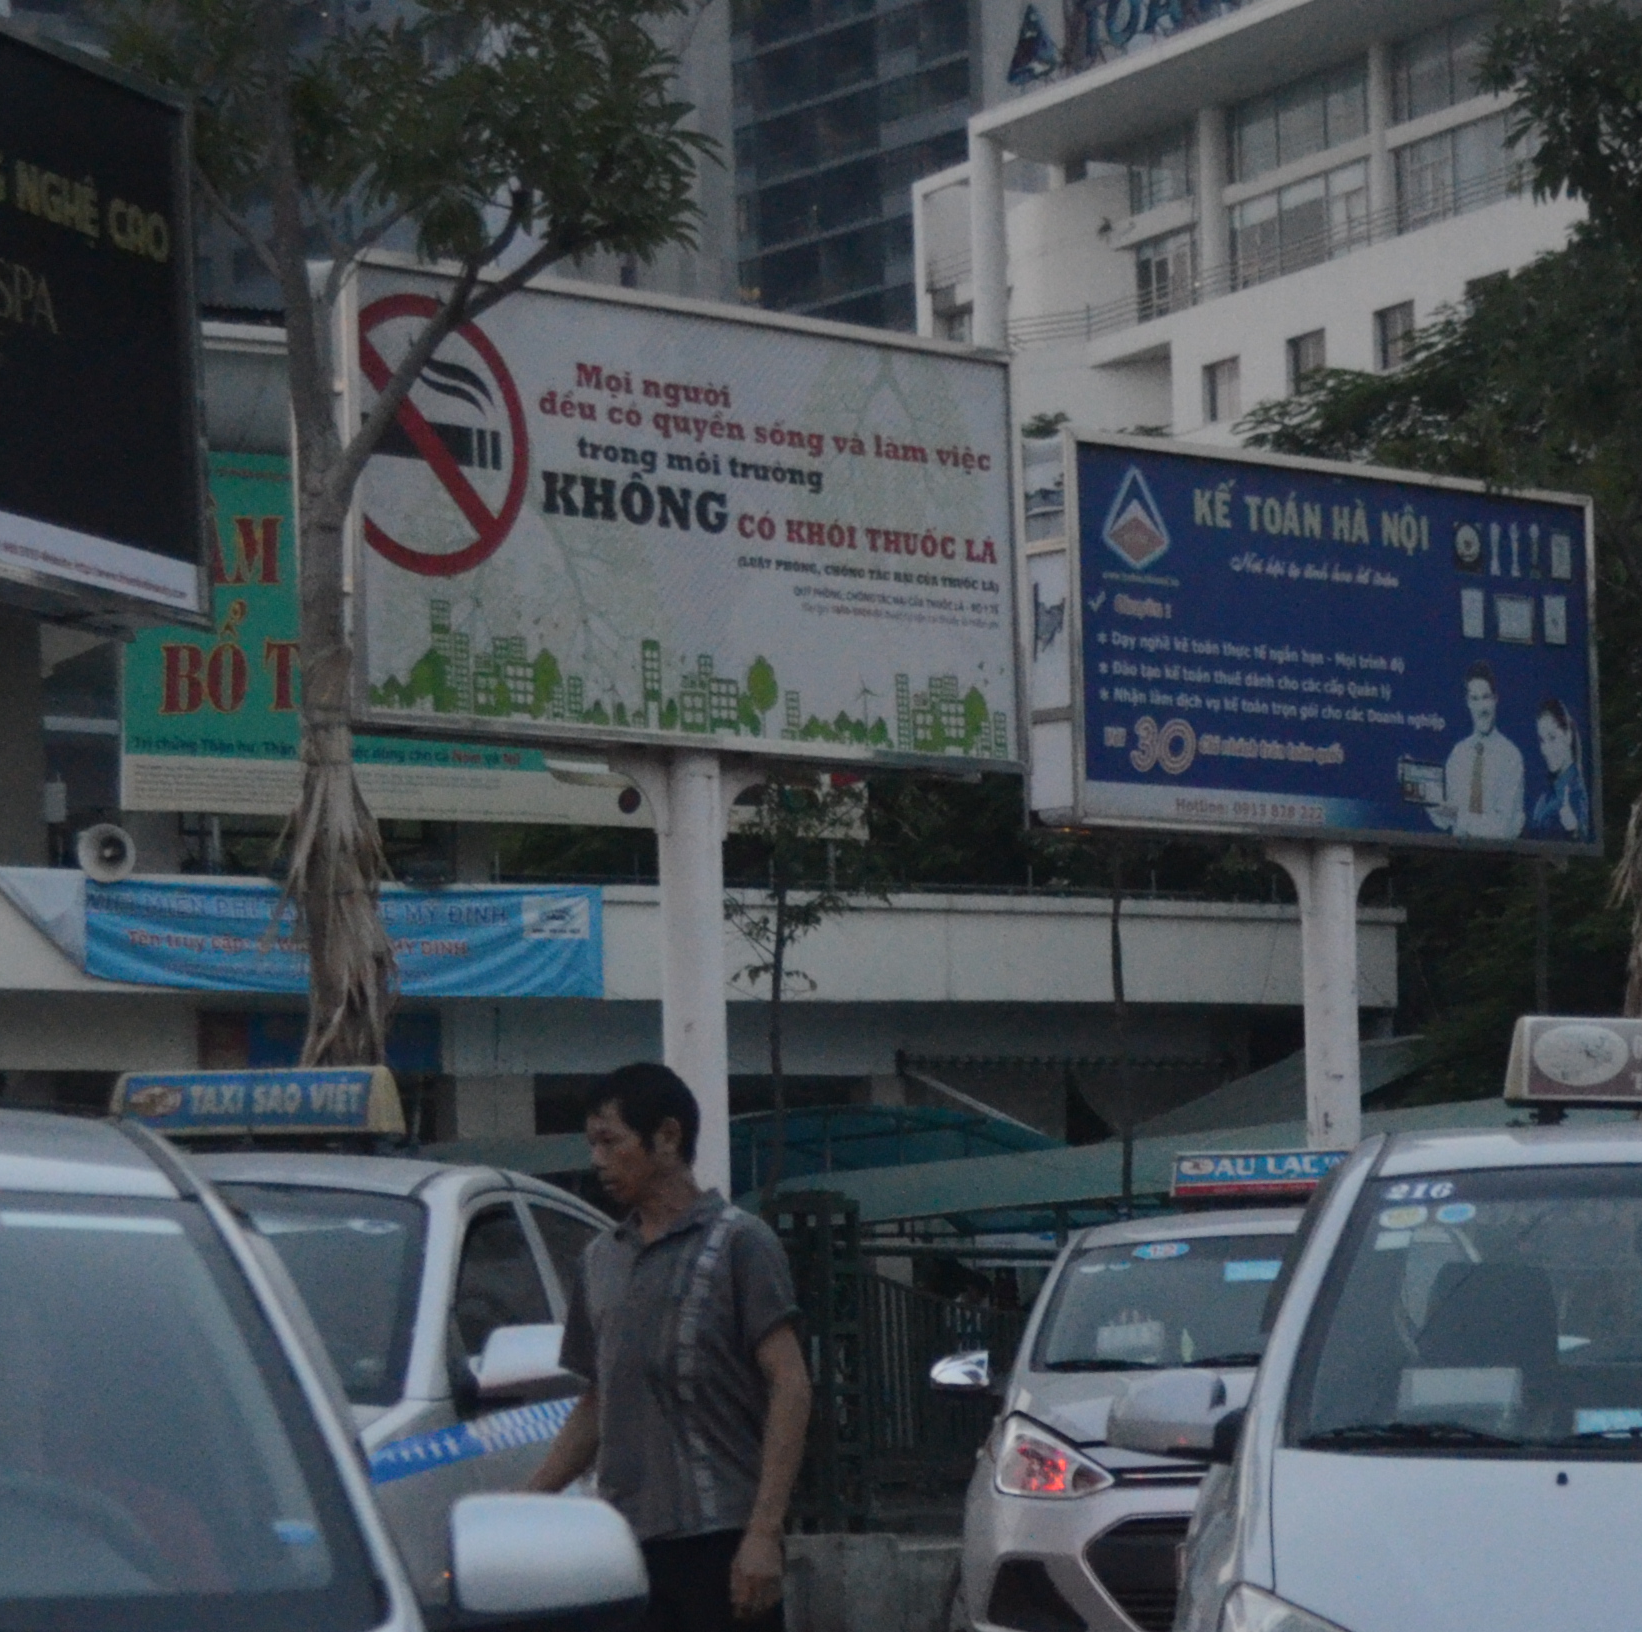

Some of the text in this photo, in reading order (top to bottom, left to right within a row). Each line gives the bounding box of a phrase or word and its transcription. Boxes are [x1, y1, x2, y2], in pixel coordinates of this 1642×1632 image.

[13, 159, 101, 250] NGHỆ
[107, 197, 171, 264] CAO
[575, 363, 732, 410] Mọi người
[539, 388, 597, 422] đều
[653, 411, 746, 443] quyền
[753, 421, 824, 457] sống
[831, 431, 866, 456] và
[873, 434, 929, 464] làm
[936, 445, 992, 476] việc
[577, 437, 824, 493] trong môi trường
[540, 469, 999, 565] KHÔNG CÓ KHÓI THUỐC LÁ
[1192, 478, 1430, 556] KẾ TOÁN HÀ NỘI
[160, 600, 249, 714] BỔ
[1128, 714, 1198, 775] 30
[188, 1083, 245, 1116] TAXI
[252, 1082, 303, 1115] SAO
[1383, 1181, 1454, 1199] 216
